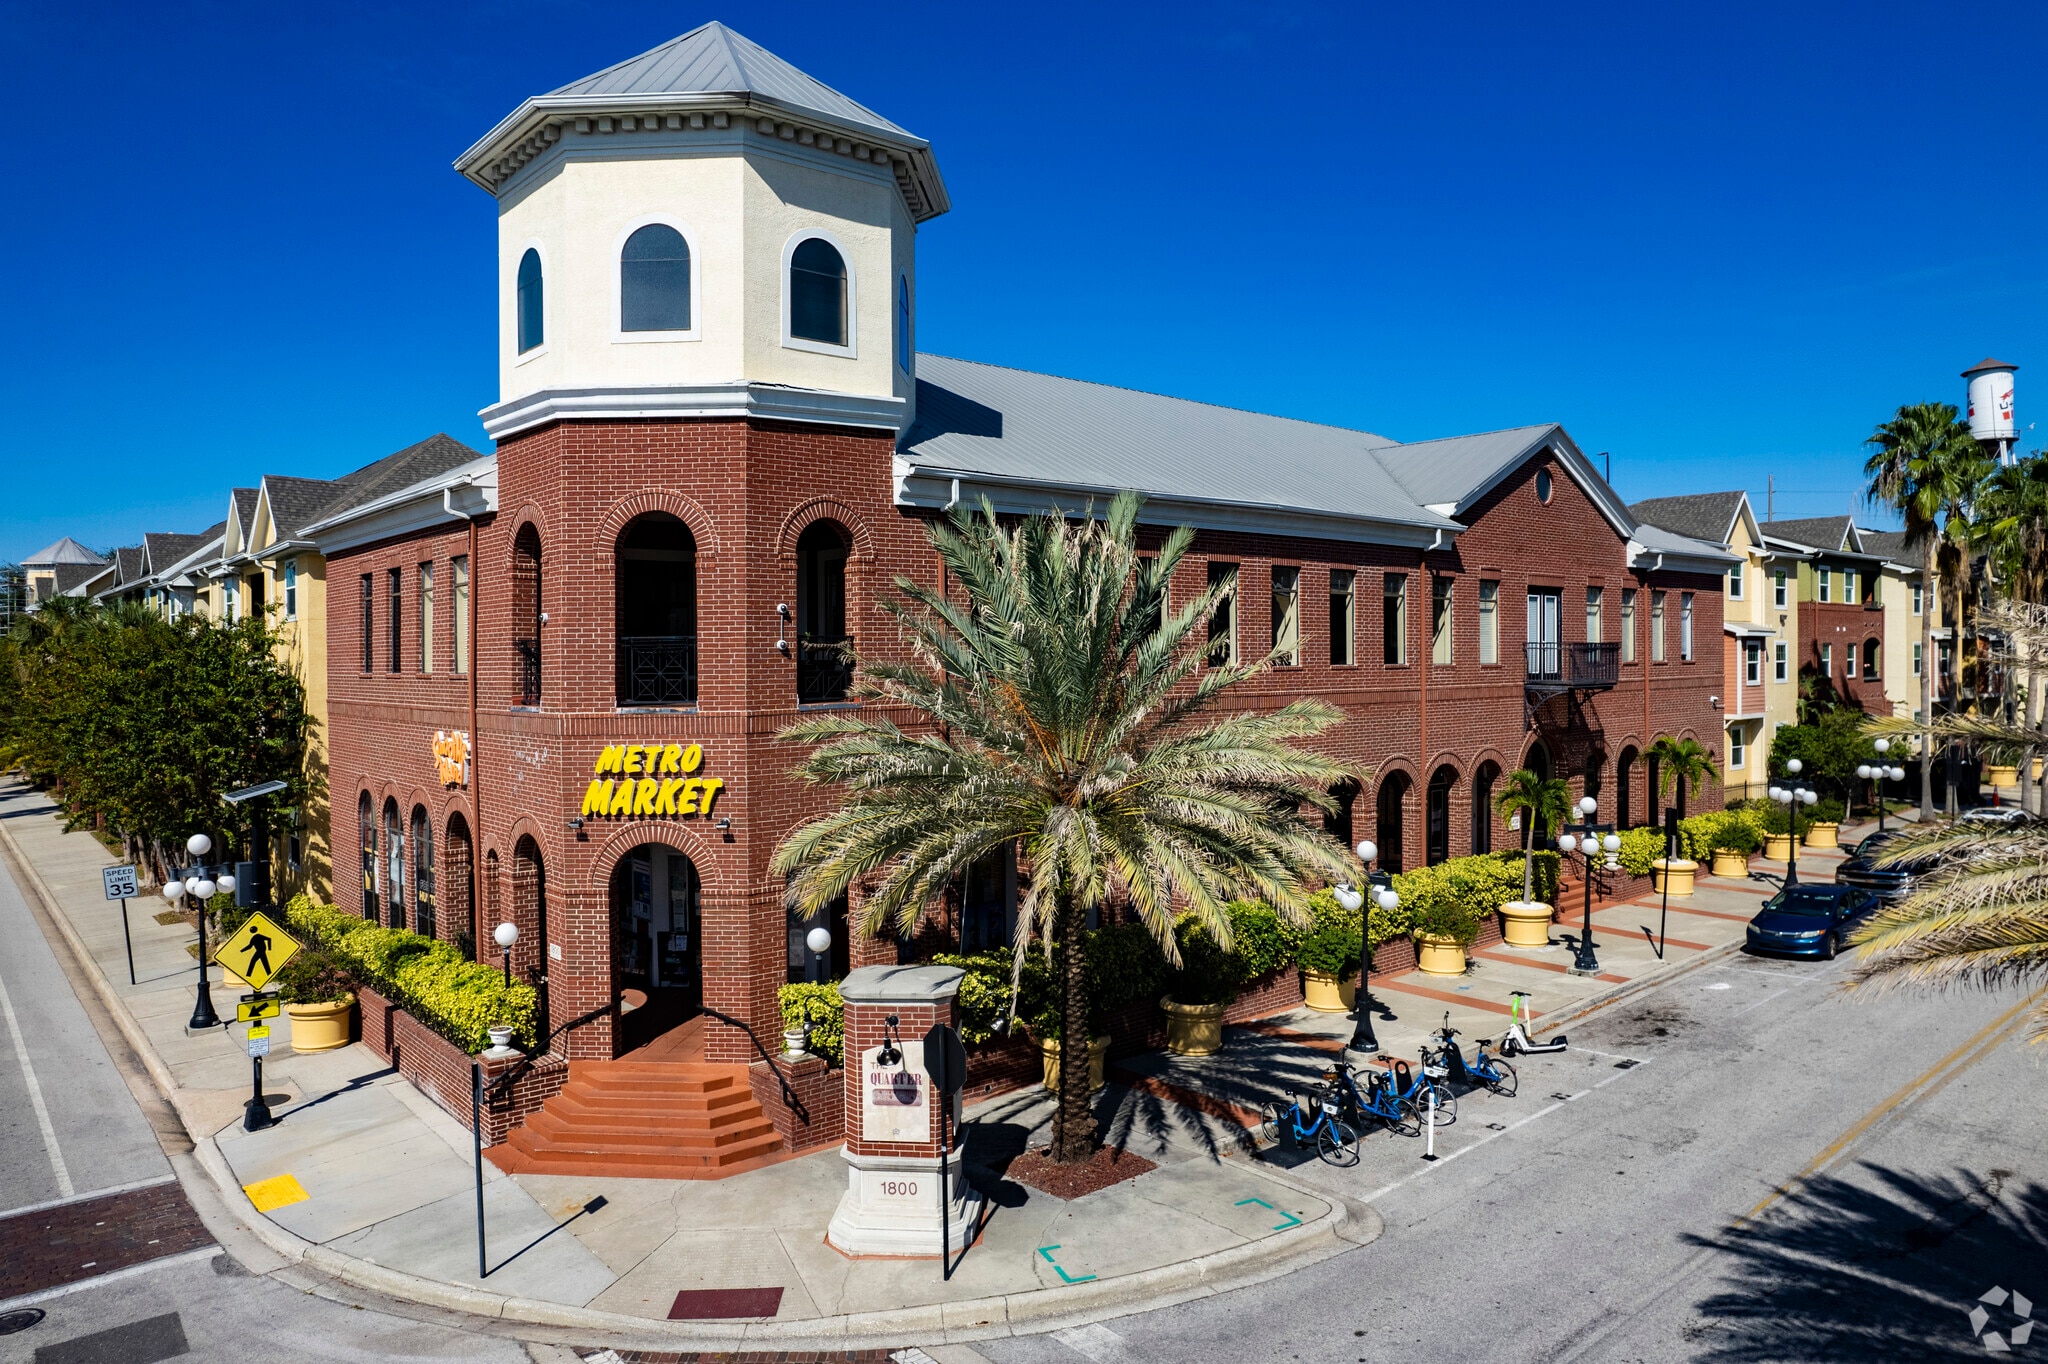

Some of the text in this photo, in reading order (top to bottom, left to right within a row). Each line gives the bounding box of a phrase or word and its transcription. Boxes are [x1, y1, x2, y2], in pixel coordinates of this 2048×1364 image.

[595, 744, 703, 774] METRO
[581, 778, 724, 816] MARKET
[106, 868, 134, 877] SPEED
[110, 883, 135, 896] 35
[870, 1072, 922, 1086] QUARTER
[881, 1181, 918, 1196] 1800
